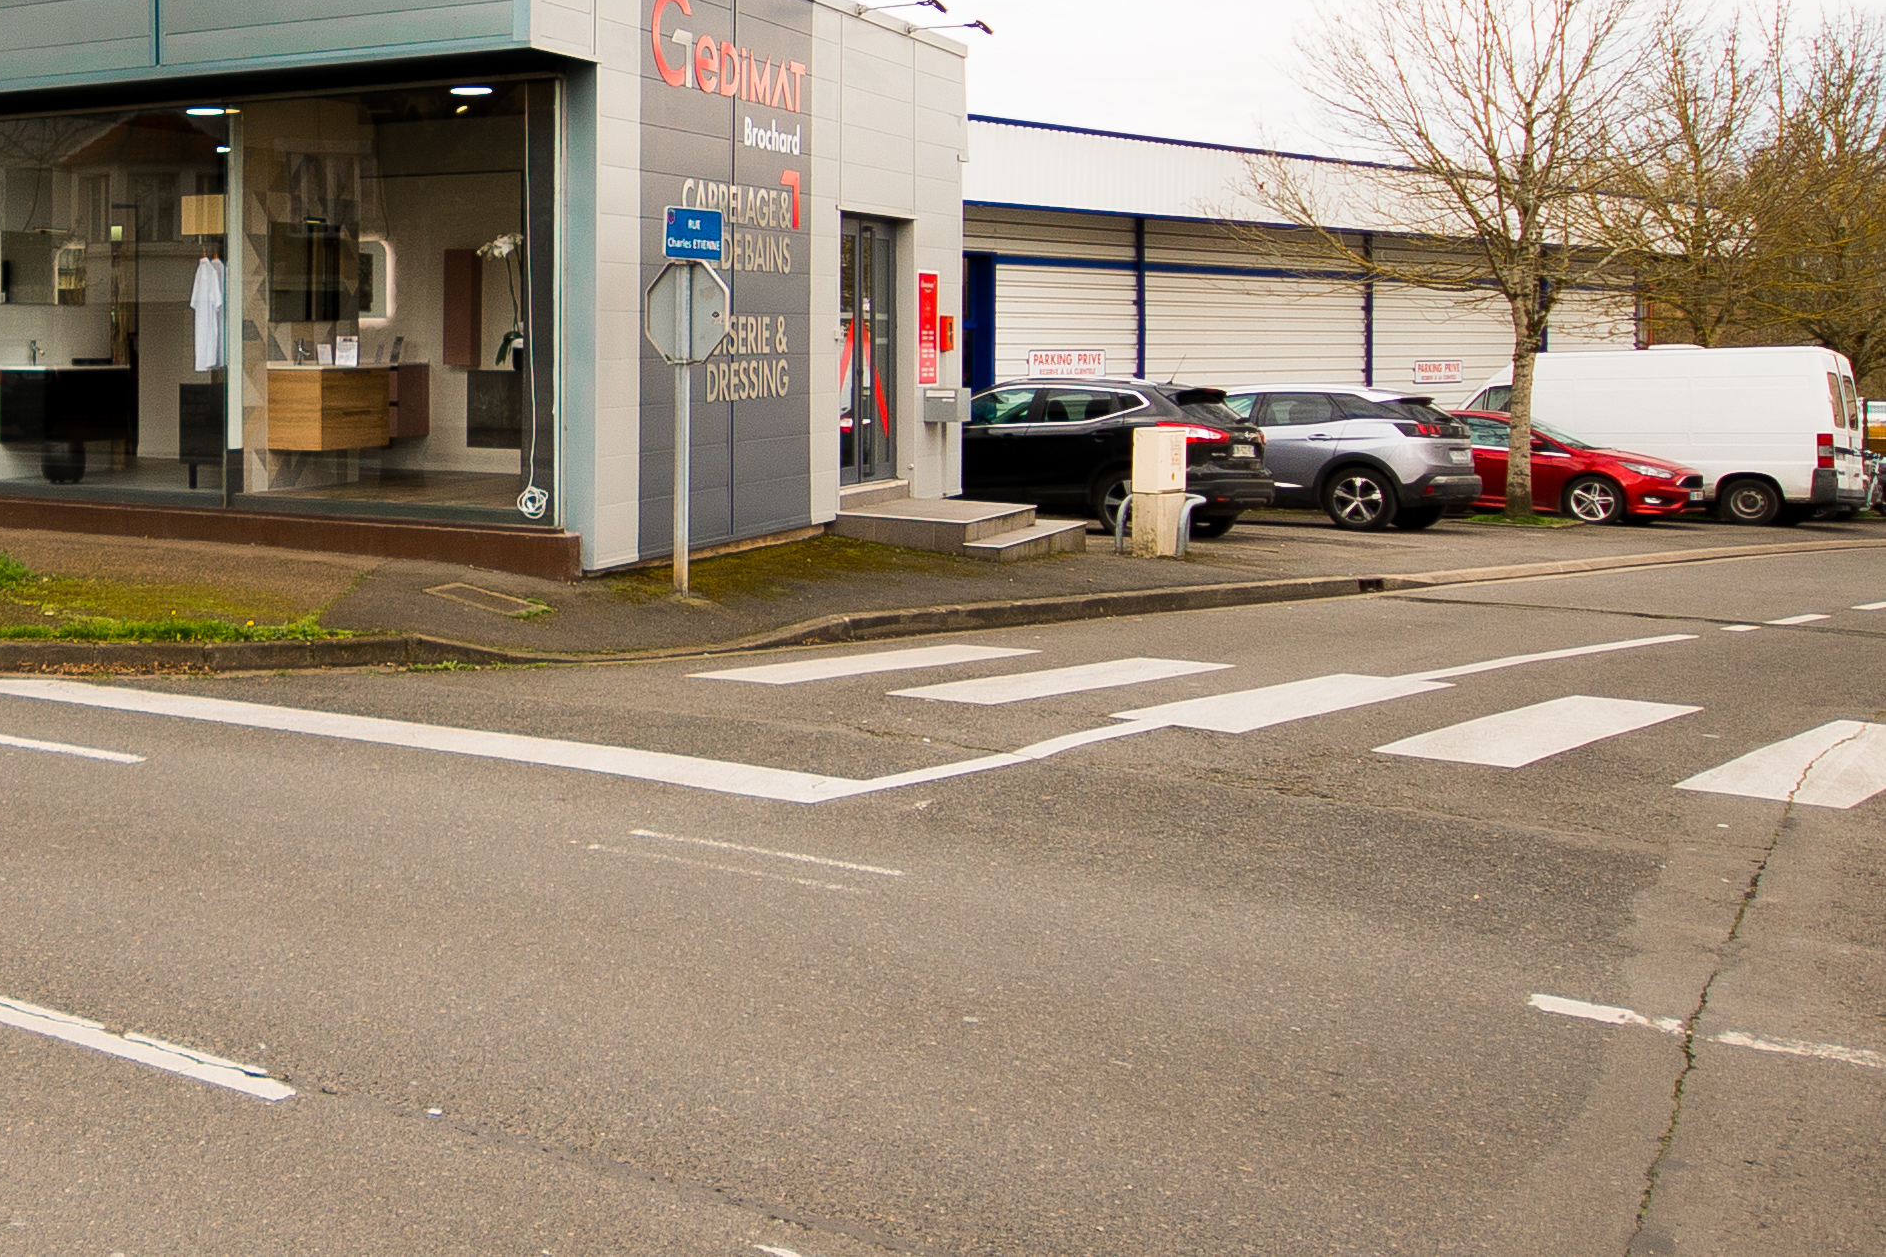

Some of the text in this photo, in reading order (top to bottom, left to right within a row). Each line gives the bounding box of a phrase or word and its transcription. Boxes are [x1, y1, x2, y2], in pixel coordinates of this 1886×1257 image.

[743, 116, 801, 156] Brochard
[688, 219, 701, 230] RUE
[667, 237, 692, 249] Charles
[722, 232, 791, 274] DE BAINS
[775, 315, 788, 354] &
[1033, 353, 1073, 365] PARKING
[1418, 363, 1442, 372] PARKING
[706, 358, 789, 403] DRESSING
